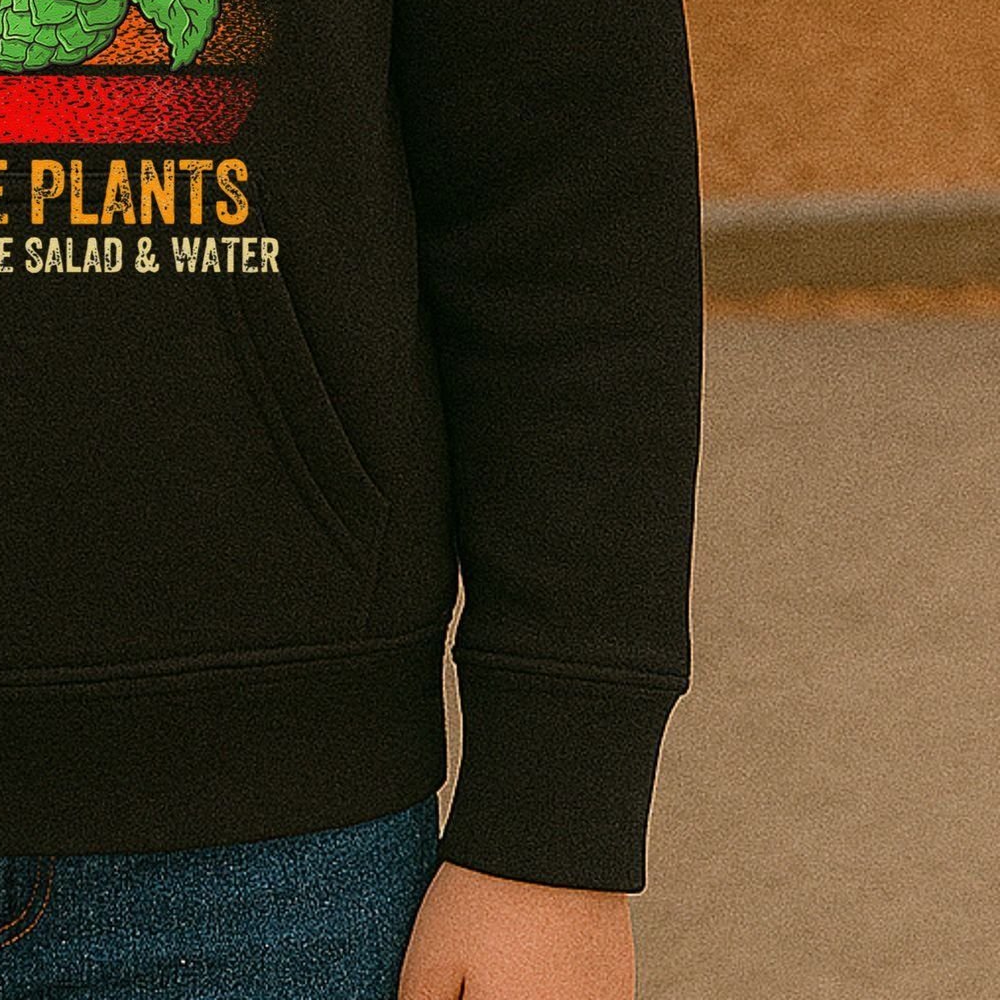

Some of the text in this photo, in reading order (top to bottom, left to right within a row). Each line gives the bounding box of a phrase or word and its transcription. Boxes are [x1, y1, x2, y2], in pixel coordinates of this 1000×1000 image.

[31, 159, 248, 225] PLANTS
[25, 237, 123, 273] SALAD
[135, 237, 159, 273] &
[172, 237, 280, 273] WATER
